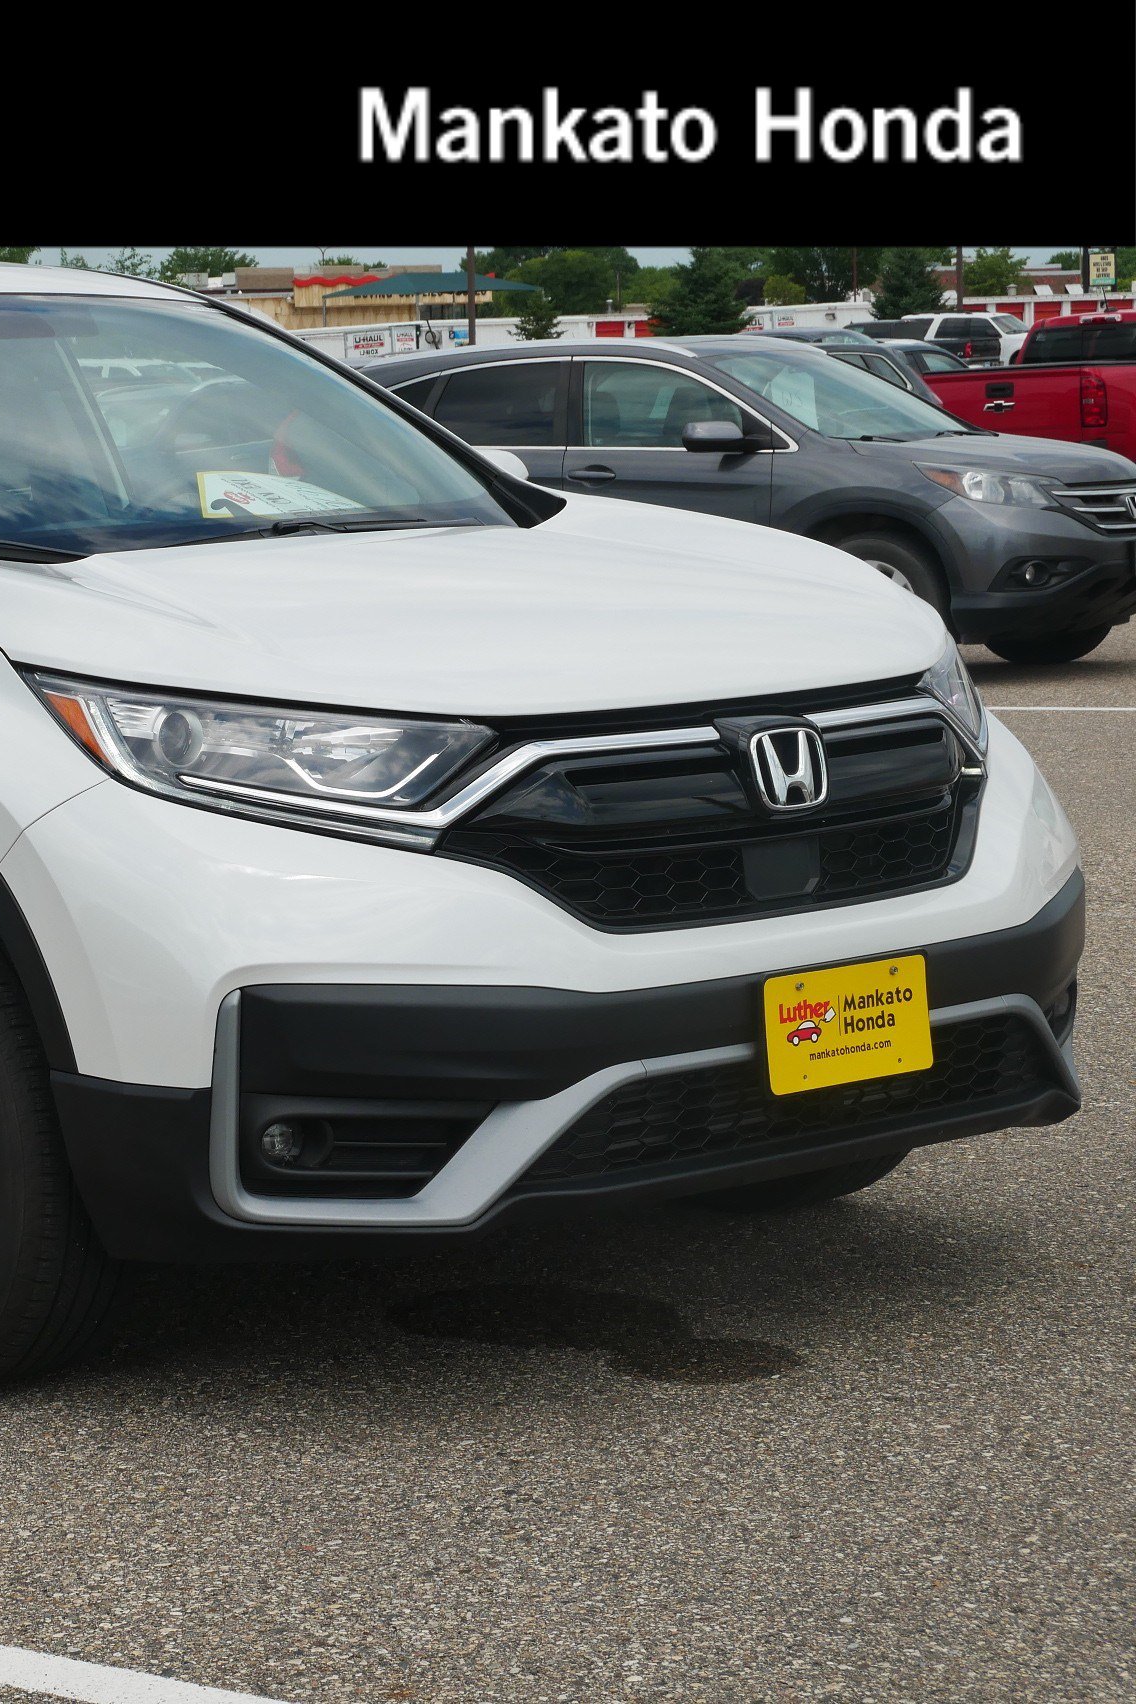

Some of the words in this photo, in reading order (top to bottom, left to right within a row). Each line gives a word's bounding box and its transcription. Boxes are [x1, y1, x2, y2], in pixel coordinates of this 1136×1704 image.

[779, 999, 830, 1024] Luther
[843, 987, 914, 1012] Mankato
[843, 1010, 896, 1035] Honda
[809, 1038, 892, 1061] mankatohonda.com
